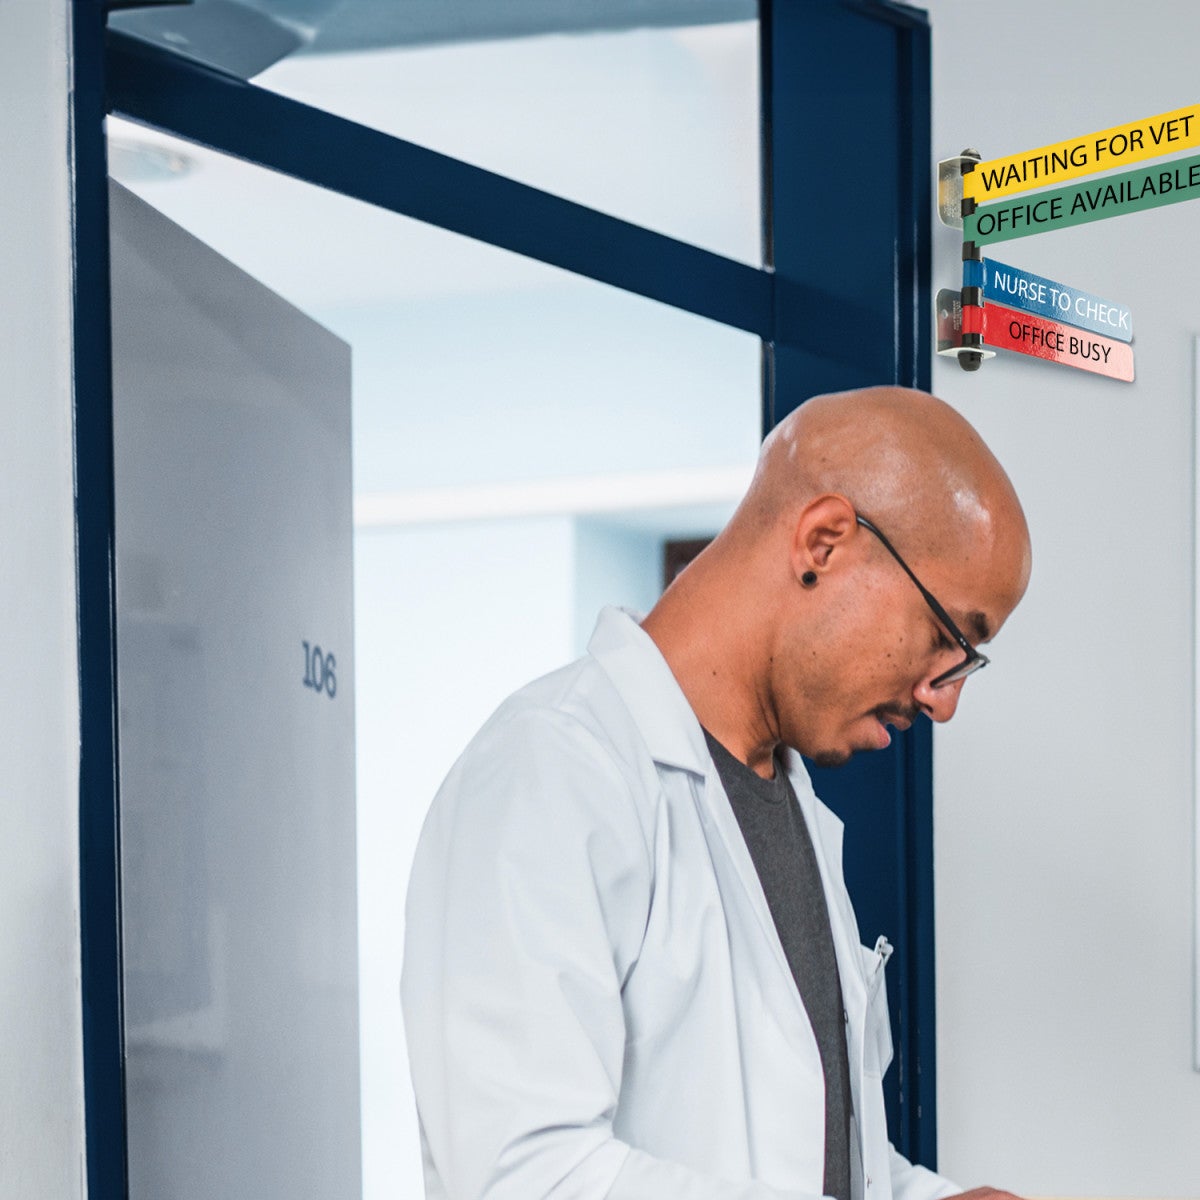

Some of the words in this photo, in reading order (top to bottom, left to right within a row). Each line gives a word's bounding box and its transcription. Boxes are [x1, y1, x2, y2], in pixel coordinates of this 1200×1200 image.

[981, 145, 1088, 191] WAITING
[1095, 129, 1144, 161] FOR
[1149, 115, 1195, 145] VET
[976, 197, 1063, 235] OFFICE
[994, 270, 1046, 304] NURSE
[1050, 288, 1071, 312] TO
[1075, 297, 1128, 330] CHECK
[1009, 321, 1064, 352] OFFICE
[1069, 336, 1112, 363] BUSY
[302, 640, 337, 699] 106
